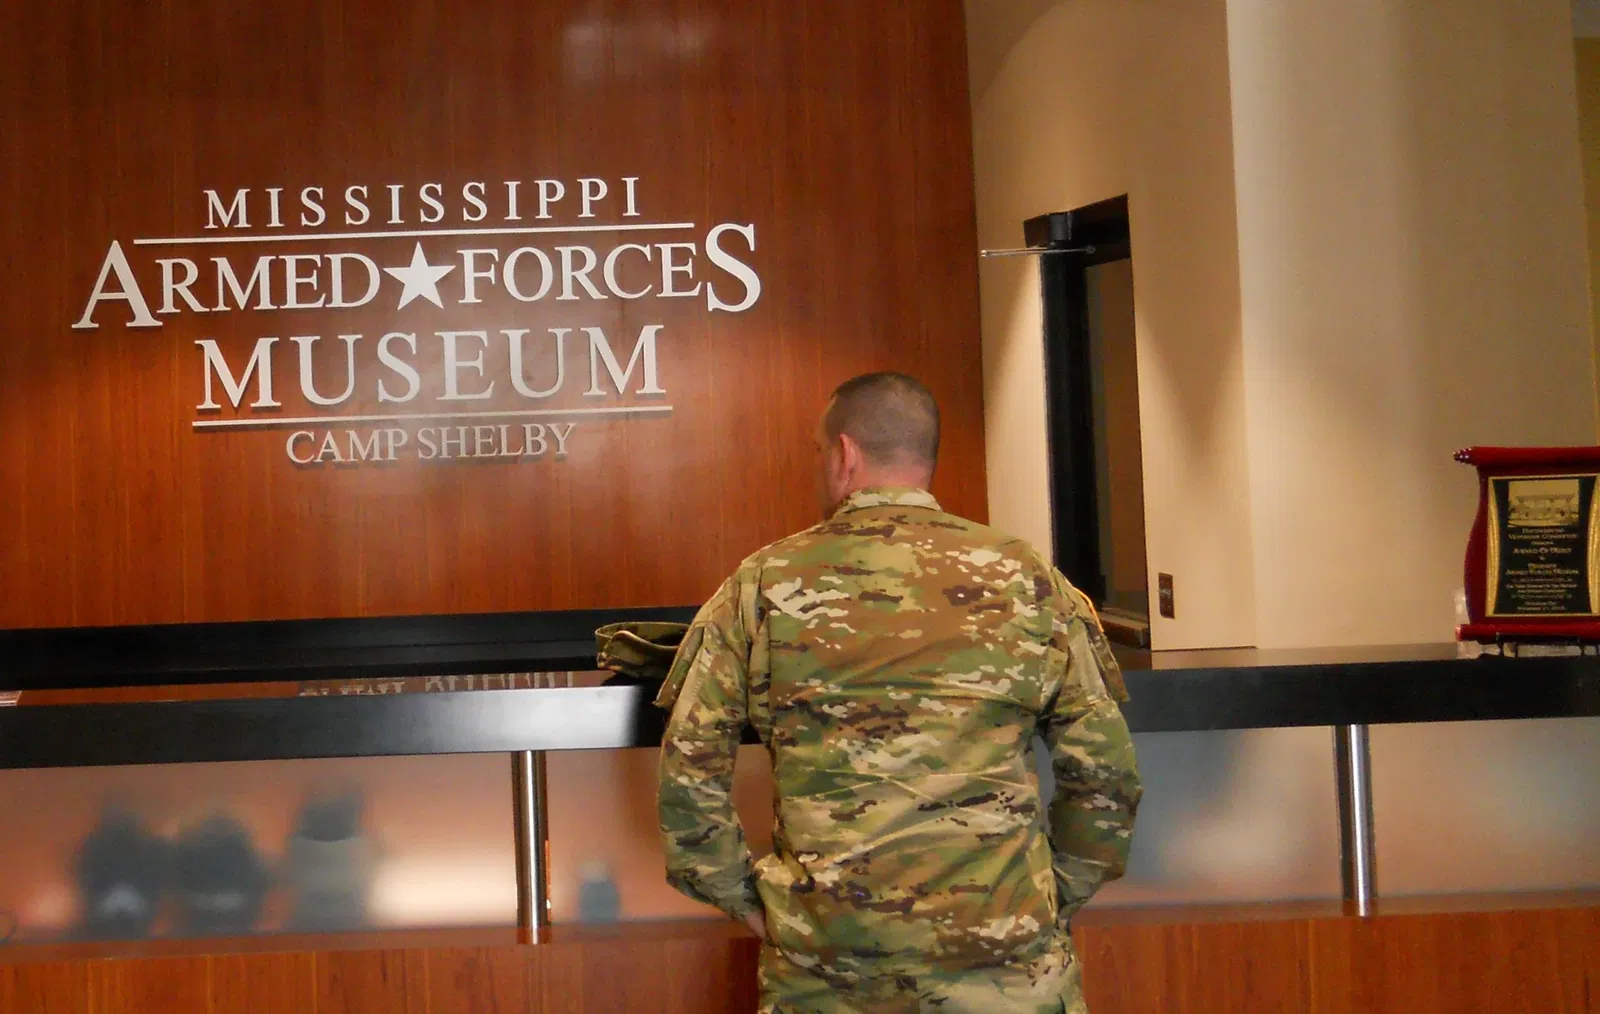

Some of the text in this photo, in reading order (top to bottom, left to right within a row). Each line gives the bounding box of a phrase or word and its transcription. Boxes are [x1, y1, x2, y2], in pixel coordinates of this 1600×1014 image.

[203, 177, 640, 228] MISSISSIPPI
[72, 223, 761, 328] ARMED FORCES
[194, 325, 666, 409] MUSEUM
[286, 422, 577, 463] CAMP SHELBY
